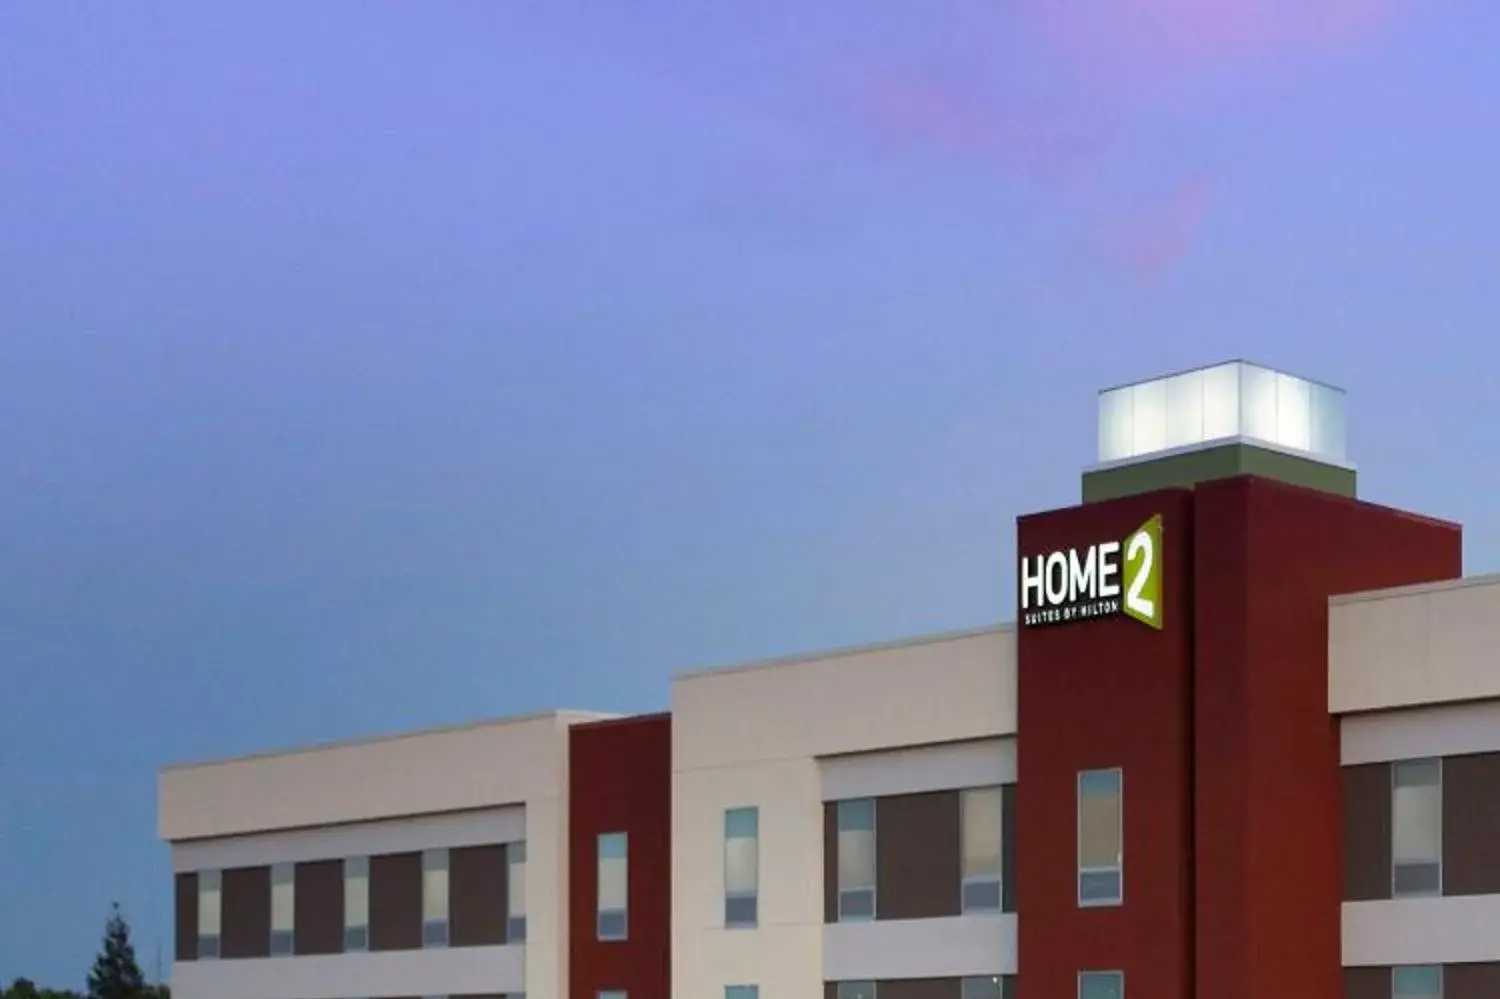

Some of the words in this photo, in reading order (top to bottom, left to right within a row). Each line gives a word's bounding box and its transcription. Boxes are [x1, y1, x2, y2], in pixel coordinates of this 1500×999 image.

[1022, 541, 1120, 609] HOME
[1127, 531, 1154, 618] 2
[1025, 609, 1060, 625] SUITES
[1063, 606, 1077, 620] BY
[1081, 600, 1118, 616] HILTON
